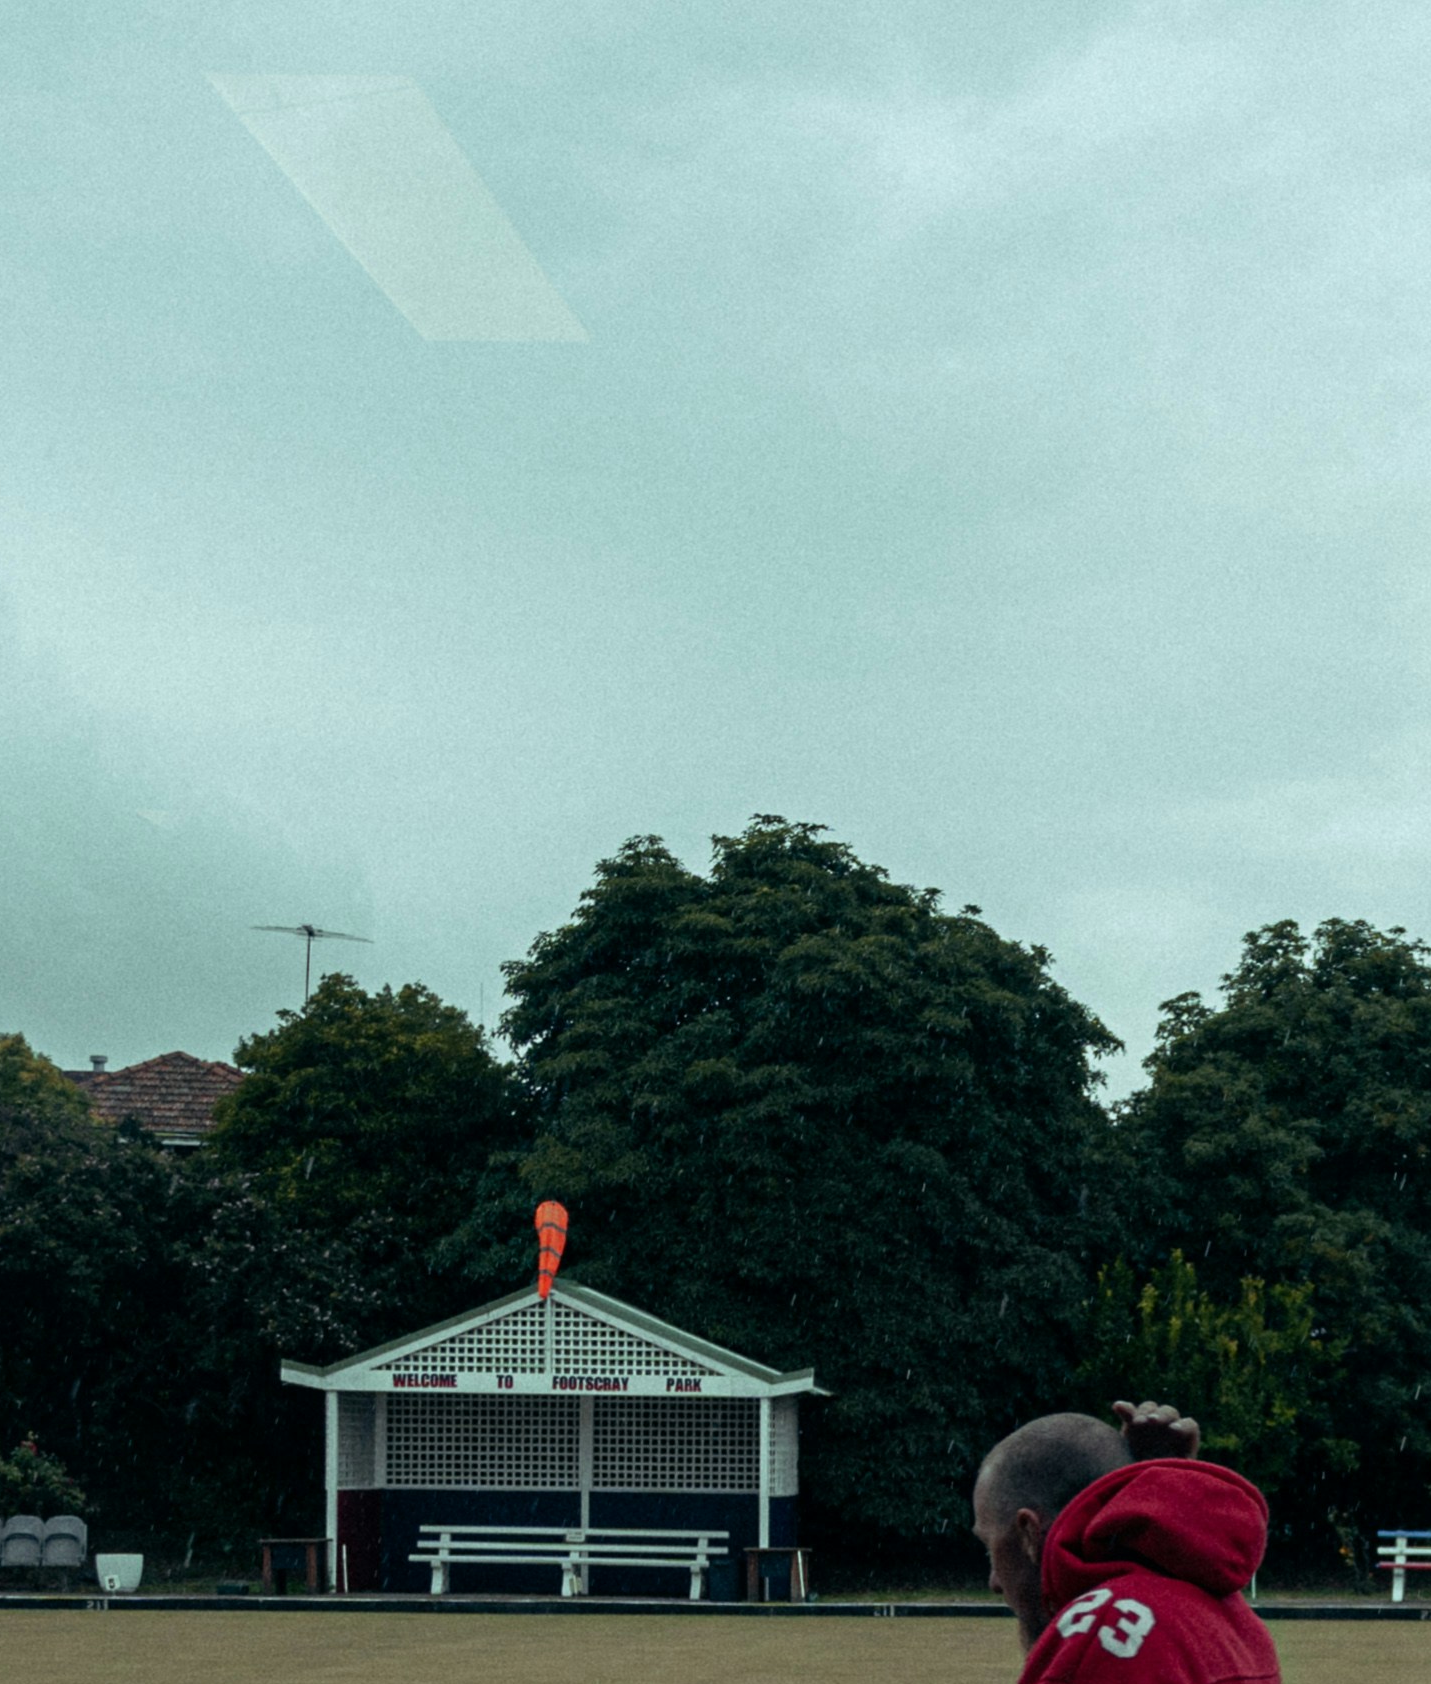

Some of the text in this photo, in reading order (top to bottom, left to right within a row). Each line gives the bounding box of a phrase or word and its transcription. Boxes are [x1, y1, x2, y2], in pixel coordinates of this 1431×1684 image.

[393, 1373, 702, 1392] WELCOME TO FOOTSCRAY PARK
[1056, 1588, 1157, 1659] 23
